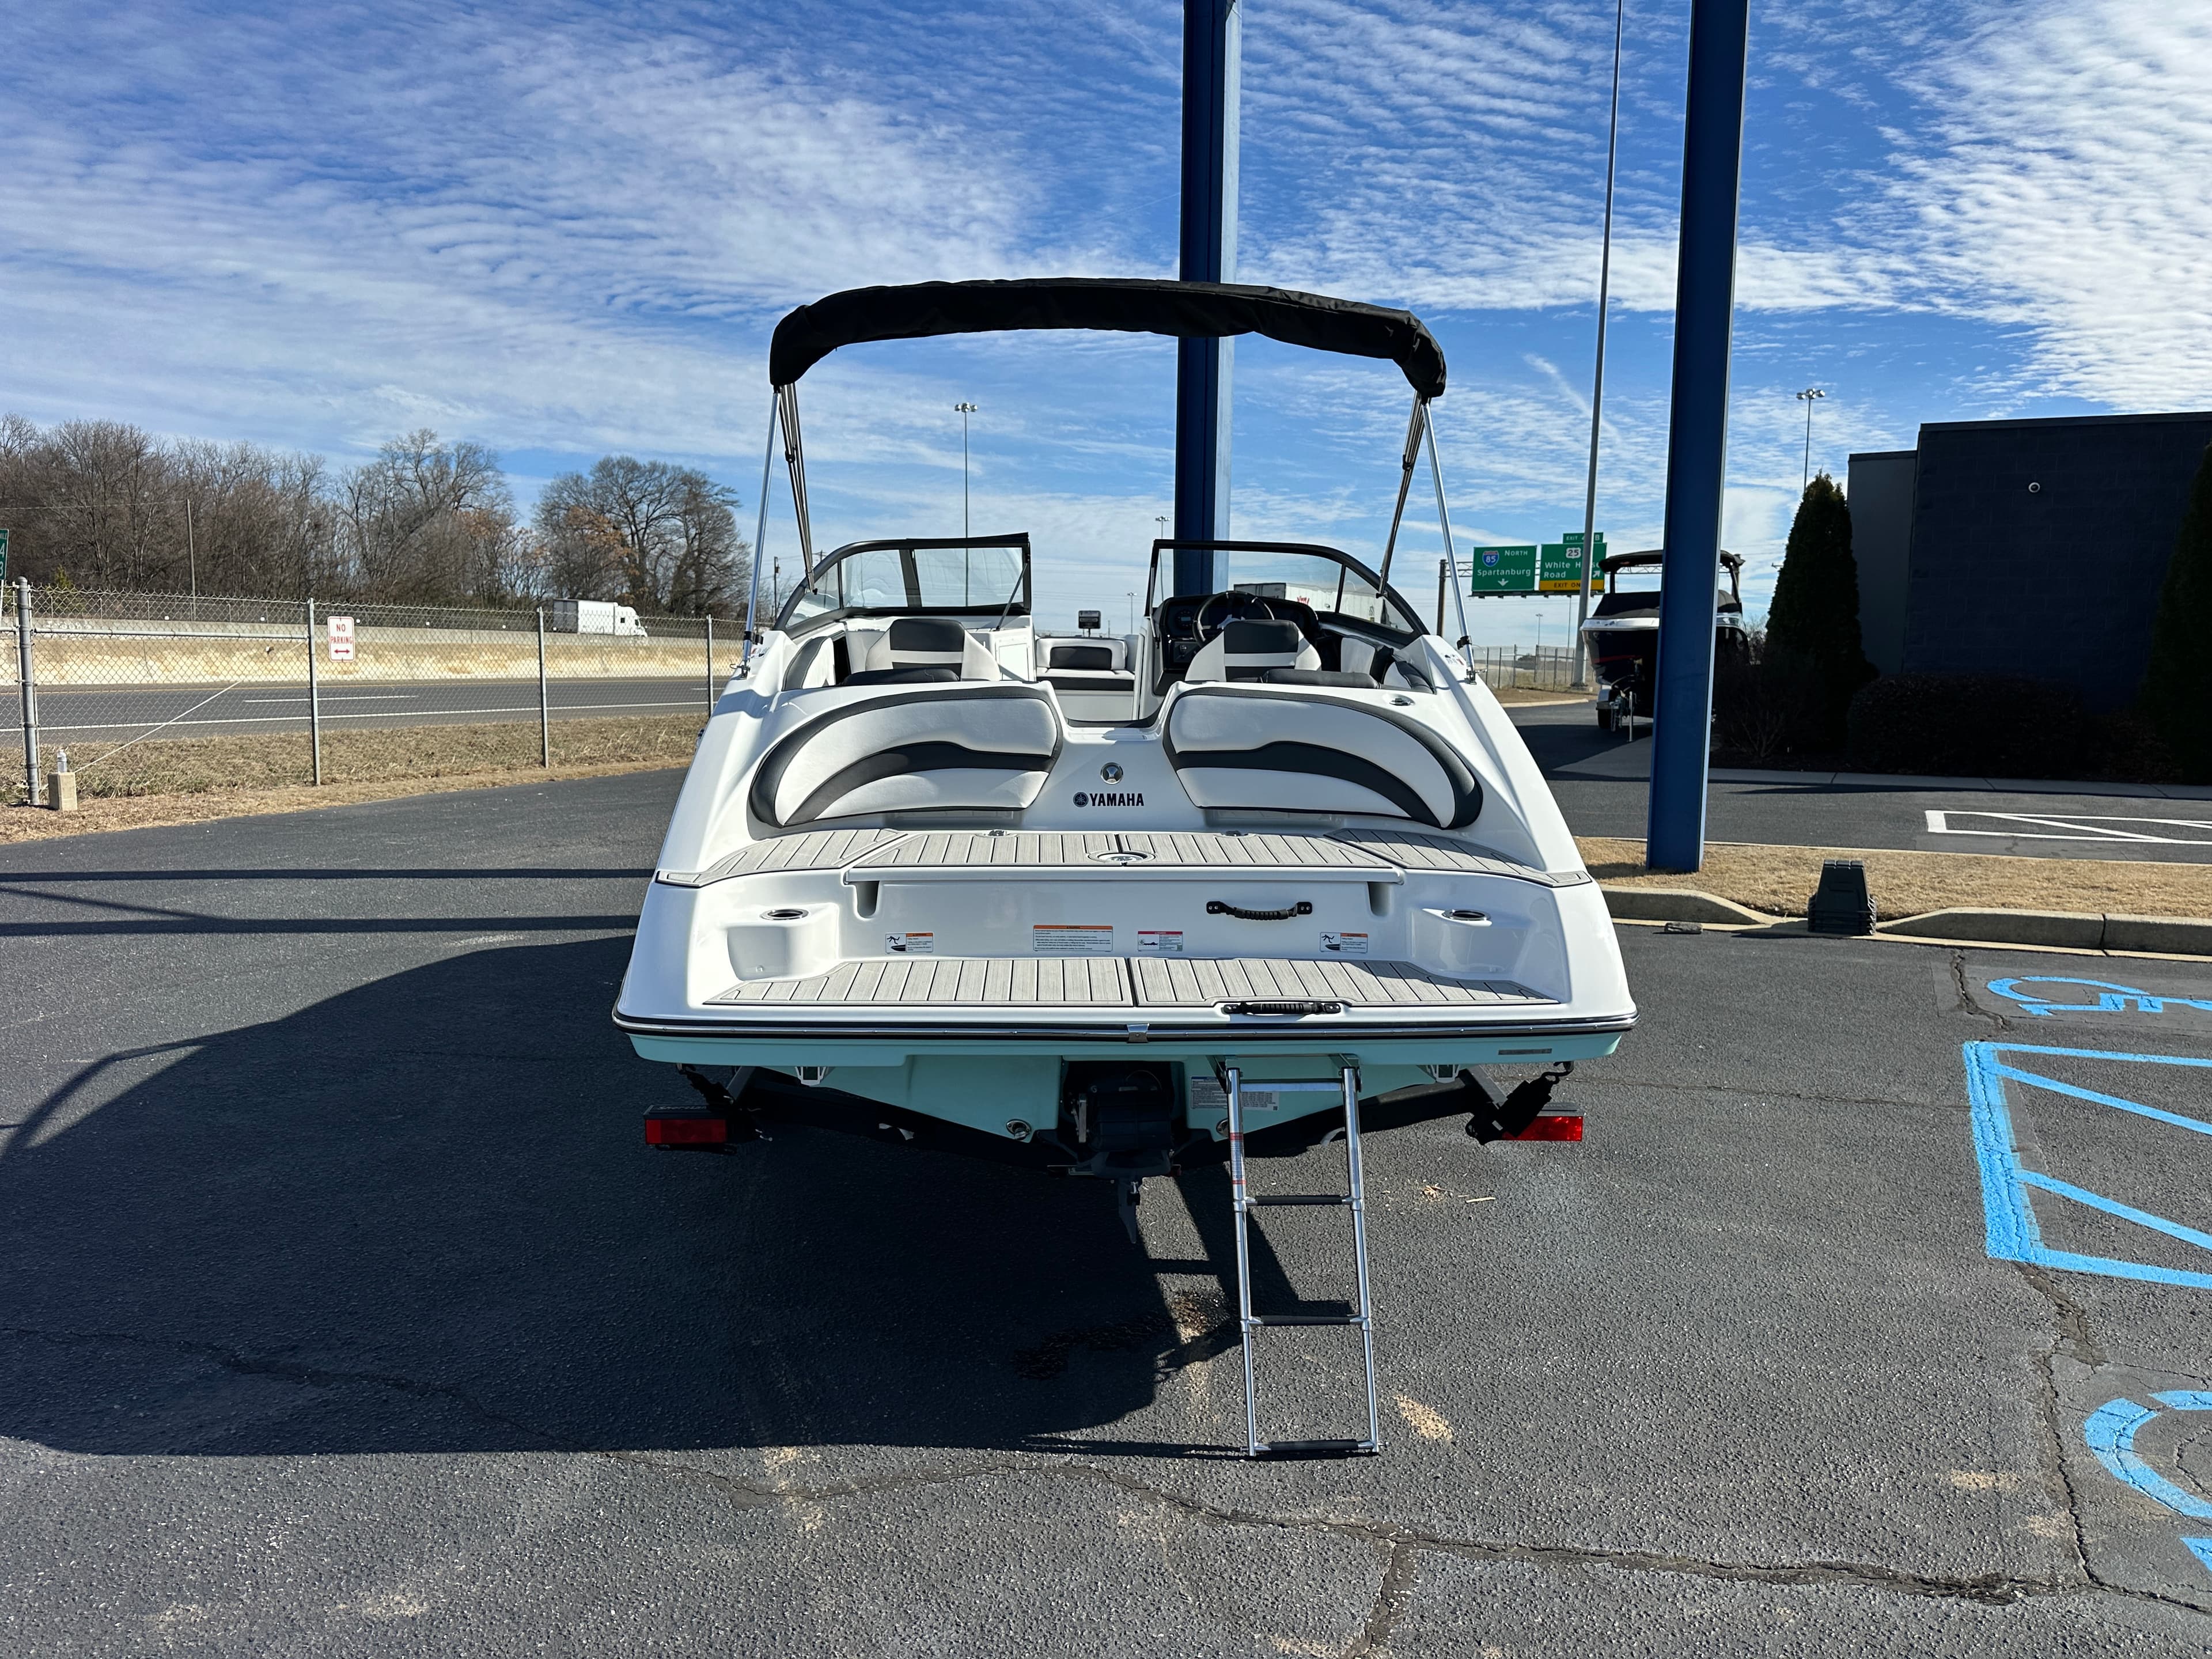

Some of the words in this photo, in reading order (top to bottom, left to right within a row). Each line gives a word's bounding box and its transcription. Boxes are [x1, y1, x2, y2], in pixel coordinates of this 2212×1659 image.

[1477, 569, 1531, 577] Spartanburg
[336, 624, 346, 632] NO
[331, 636, 353, 645] PARKING
[1089, 793, 1144, 806] YAMAHA
